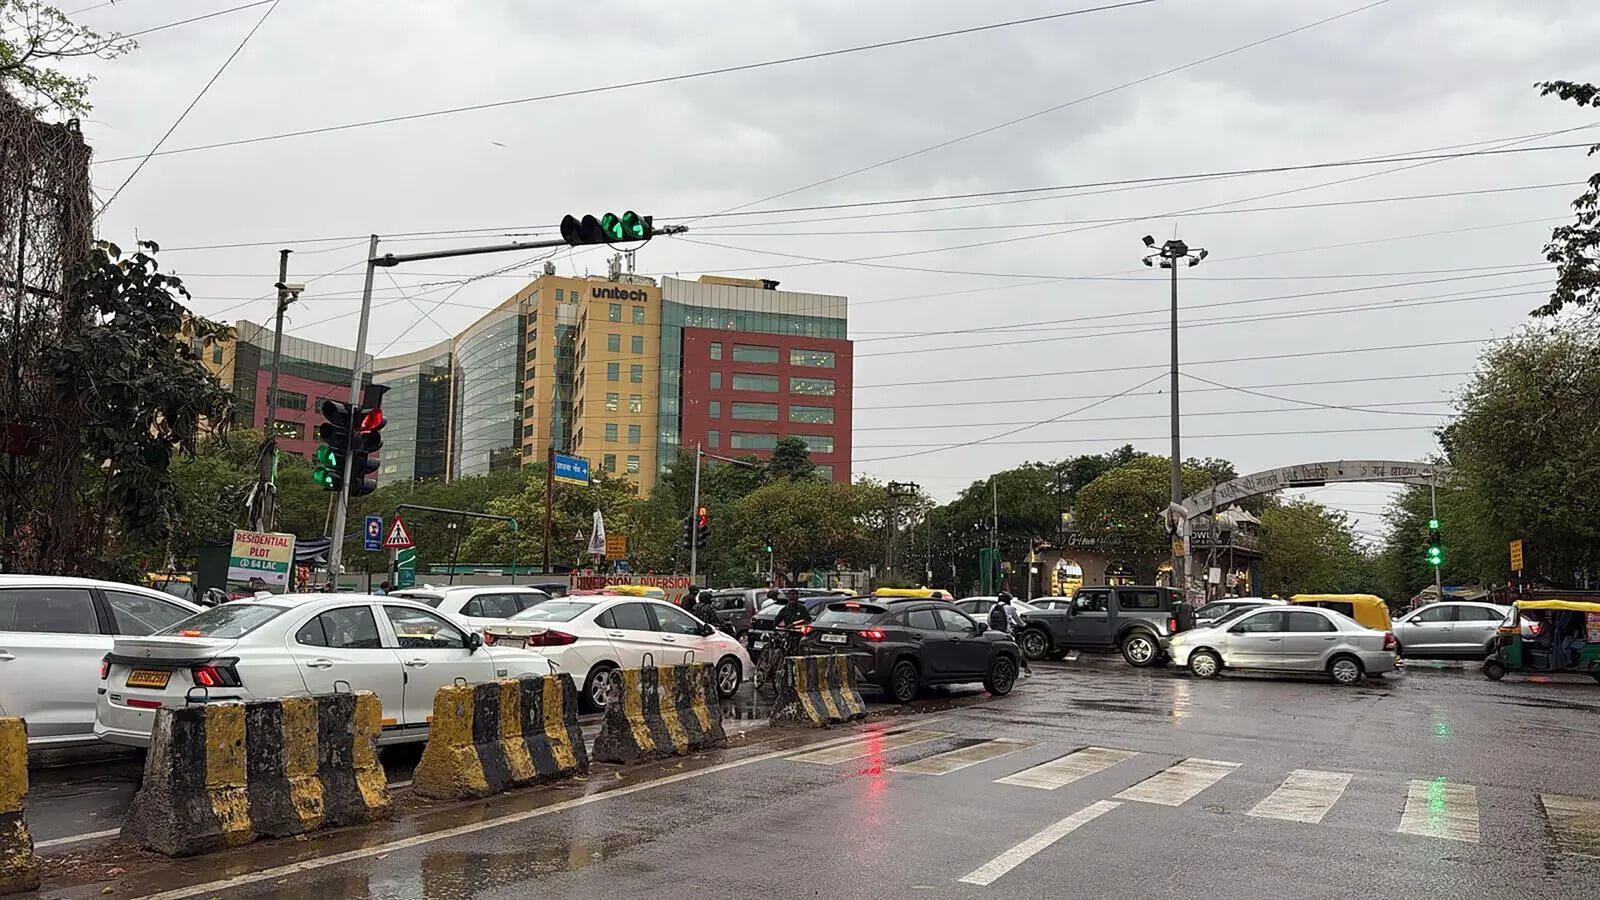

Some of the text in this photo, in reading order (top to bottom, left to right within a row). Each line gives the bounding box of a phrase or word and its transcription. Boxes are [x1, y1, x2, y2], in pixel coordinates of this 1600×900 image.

[592, 287, 648, 302] unitech
[236, 533, 288, 547] RESIDENTIAL
[249, 547, 270, 558] PLOT
[251, 560, 261, 568] 64
[262, 562, 277, 570] LAC
[576, 576, 691, 590] DIVERSION DIVERSION
